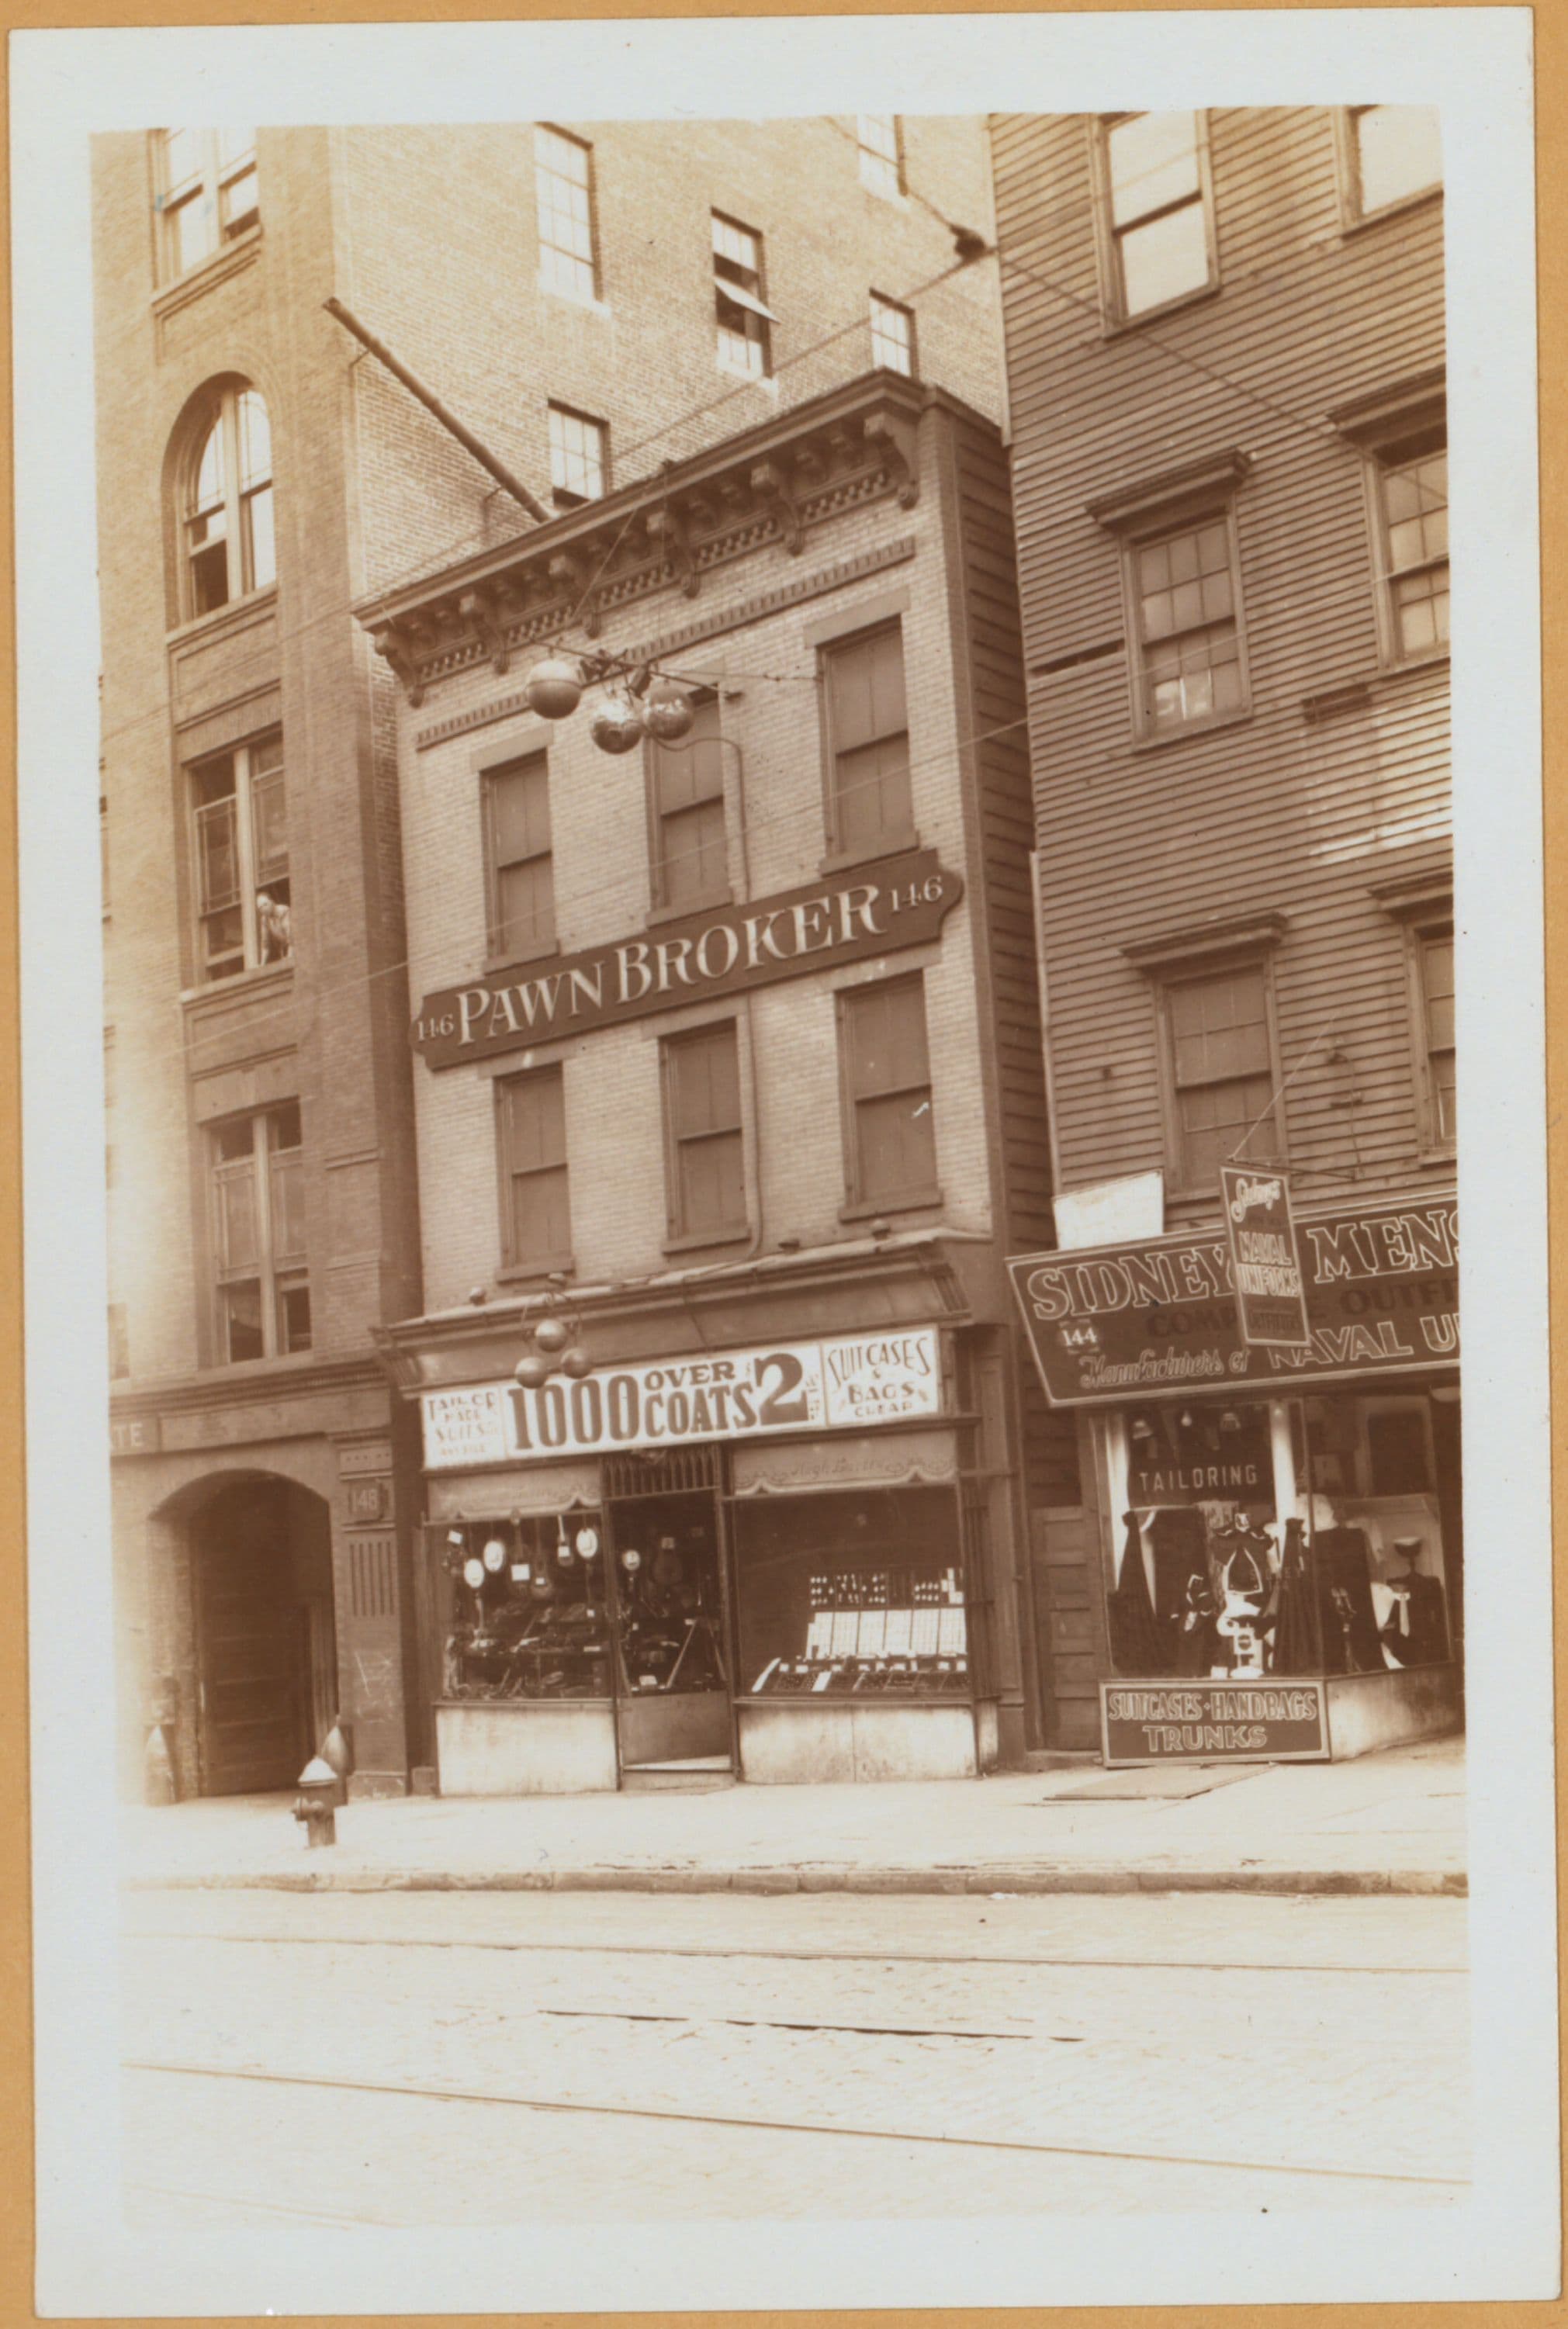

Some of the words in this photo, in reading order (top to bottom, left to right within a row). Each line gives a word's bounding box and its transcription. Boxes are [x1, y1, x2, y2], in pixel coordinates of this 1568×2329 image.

[417, 1013, 455, 1042] 146
[456, 964, 608, 1045] PAWN
[614, 884, 888, 1005] BROKER
[889, 875, 944, 913] 146
[1238, 1230, 1293, 1266] NAVAL
[1027, 1243, 1238, 1320] SIDNEY
[1237, 1262, 1301, 1298] UNIFORMS
[1062, 1327, 1098, 1346] 144
[1419, 1312, 1459, 1353] U
[644, 1361, 736, 1391] OVER
[827, 1337, 931, 1389] SUITCASES
[645, 1381, 757, 1438] COATS
[848, 1381, 915, 1405] BAGS
[508, 1375, 639, 1449] 1000
[1139, 1465, 1258, 1490] TAILORING
[1109, 1692, 1203, 1721] SUITCASES
[1210, 1691, 1317, 1722] HANDBAGS
[1143, 1725, 1268, 1753] TRUNKS
